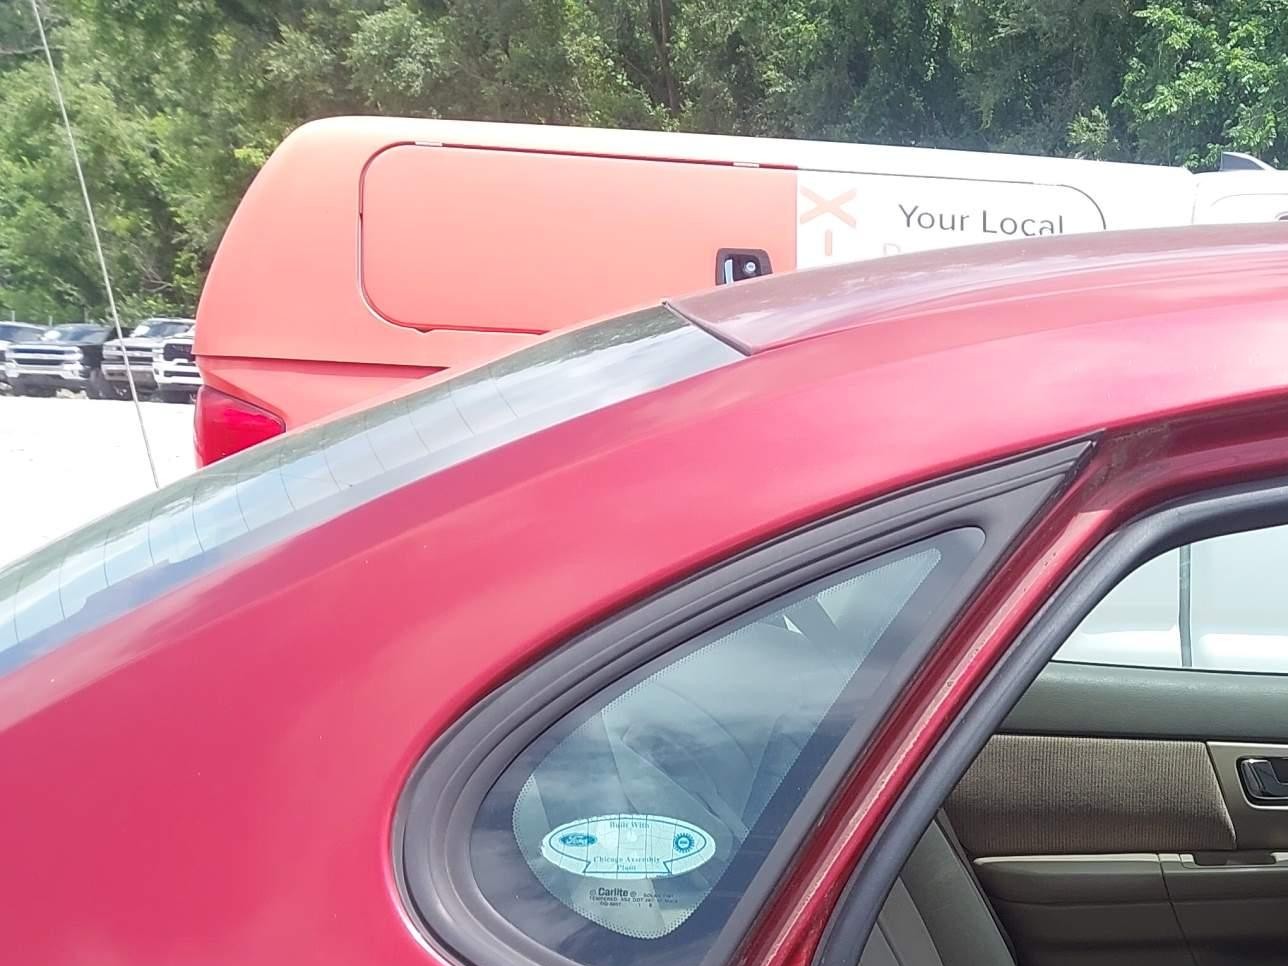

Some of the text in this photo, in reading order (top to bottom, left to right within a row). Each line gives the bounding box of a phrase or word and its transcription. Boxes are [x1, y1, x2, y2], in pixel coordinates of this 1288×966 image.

[899, 204, 1063, 237] Your Local
[598, 887, 628, 897] Carlite
